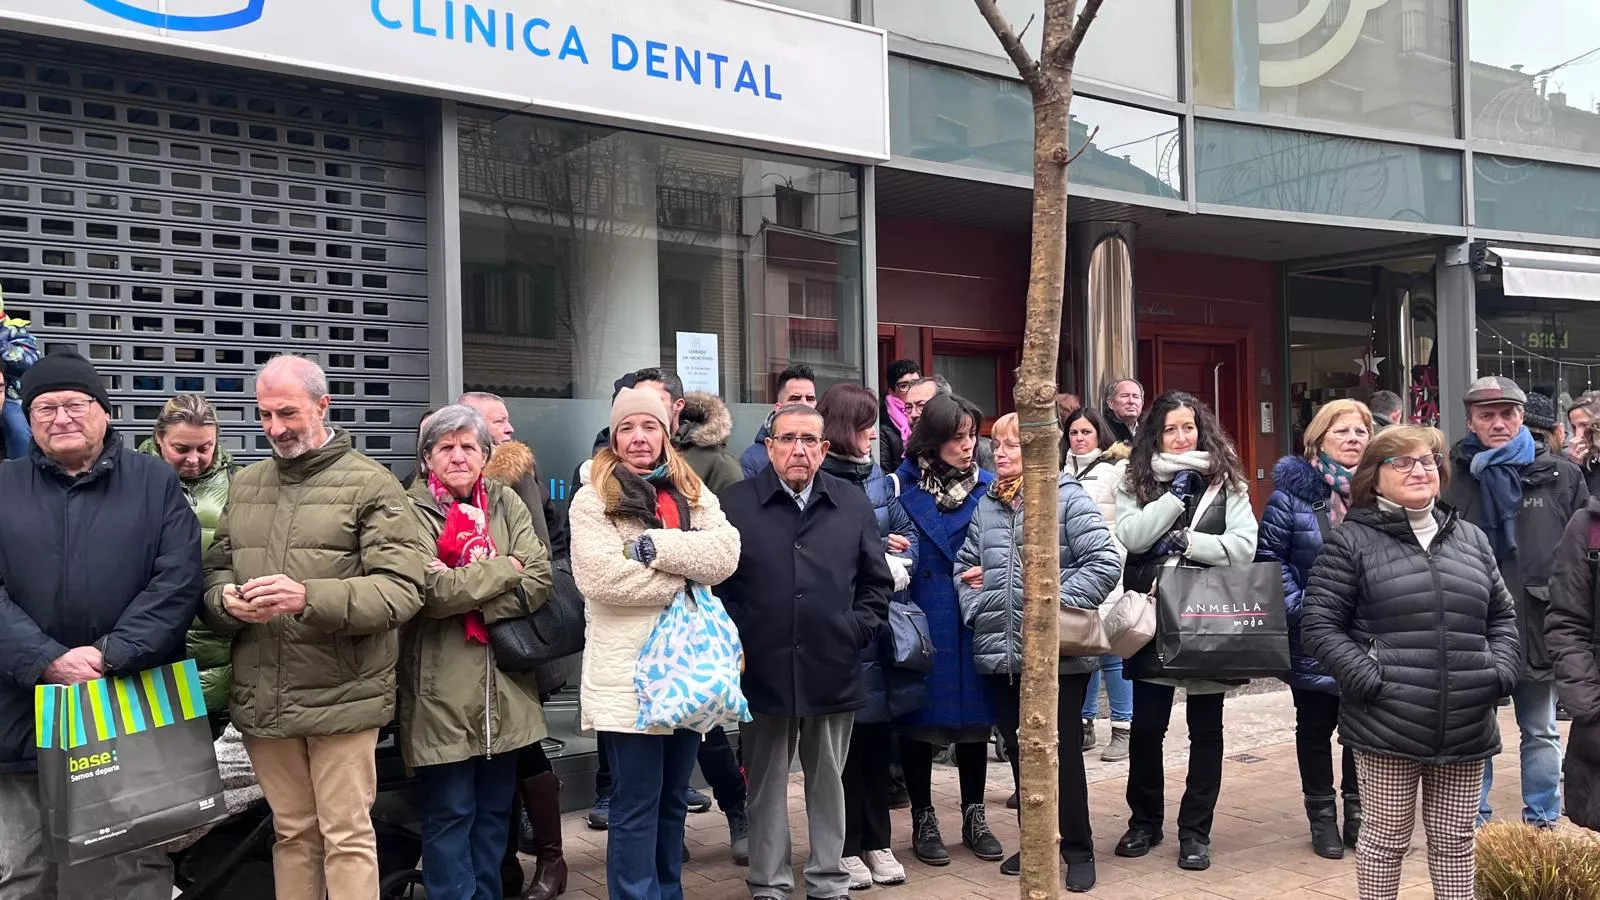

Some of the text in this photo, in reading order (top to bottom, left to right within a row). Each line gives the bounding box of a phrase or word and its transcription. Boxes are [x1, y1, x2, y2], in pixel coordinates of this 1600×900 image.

[611, 33, 782, 101] DENTAL
[1185, 602, 1262, 613] ANMELLA
[1233, 617, 1264, 628] moda
[69, 750, 118, 773] base:
[71, 770, 95, 783] Somos
